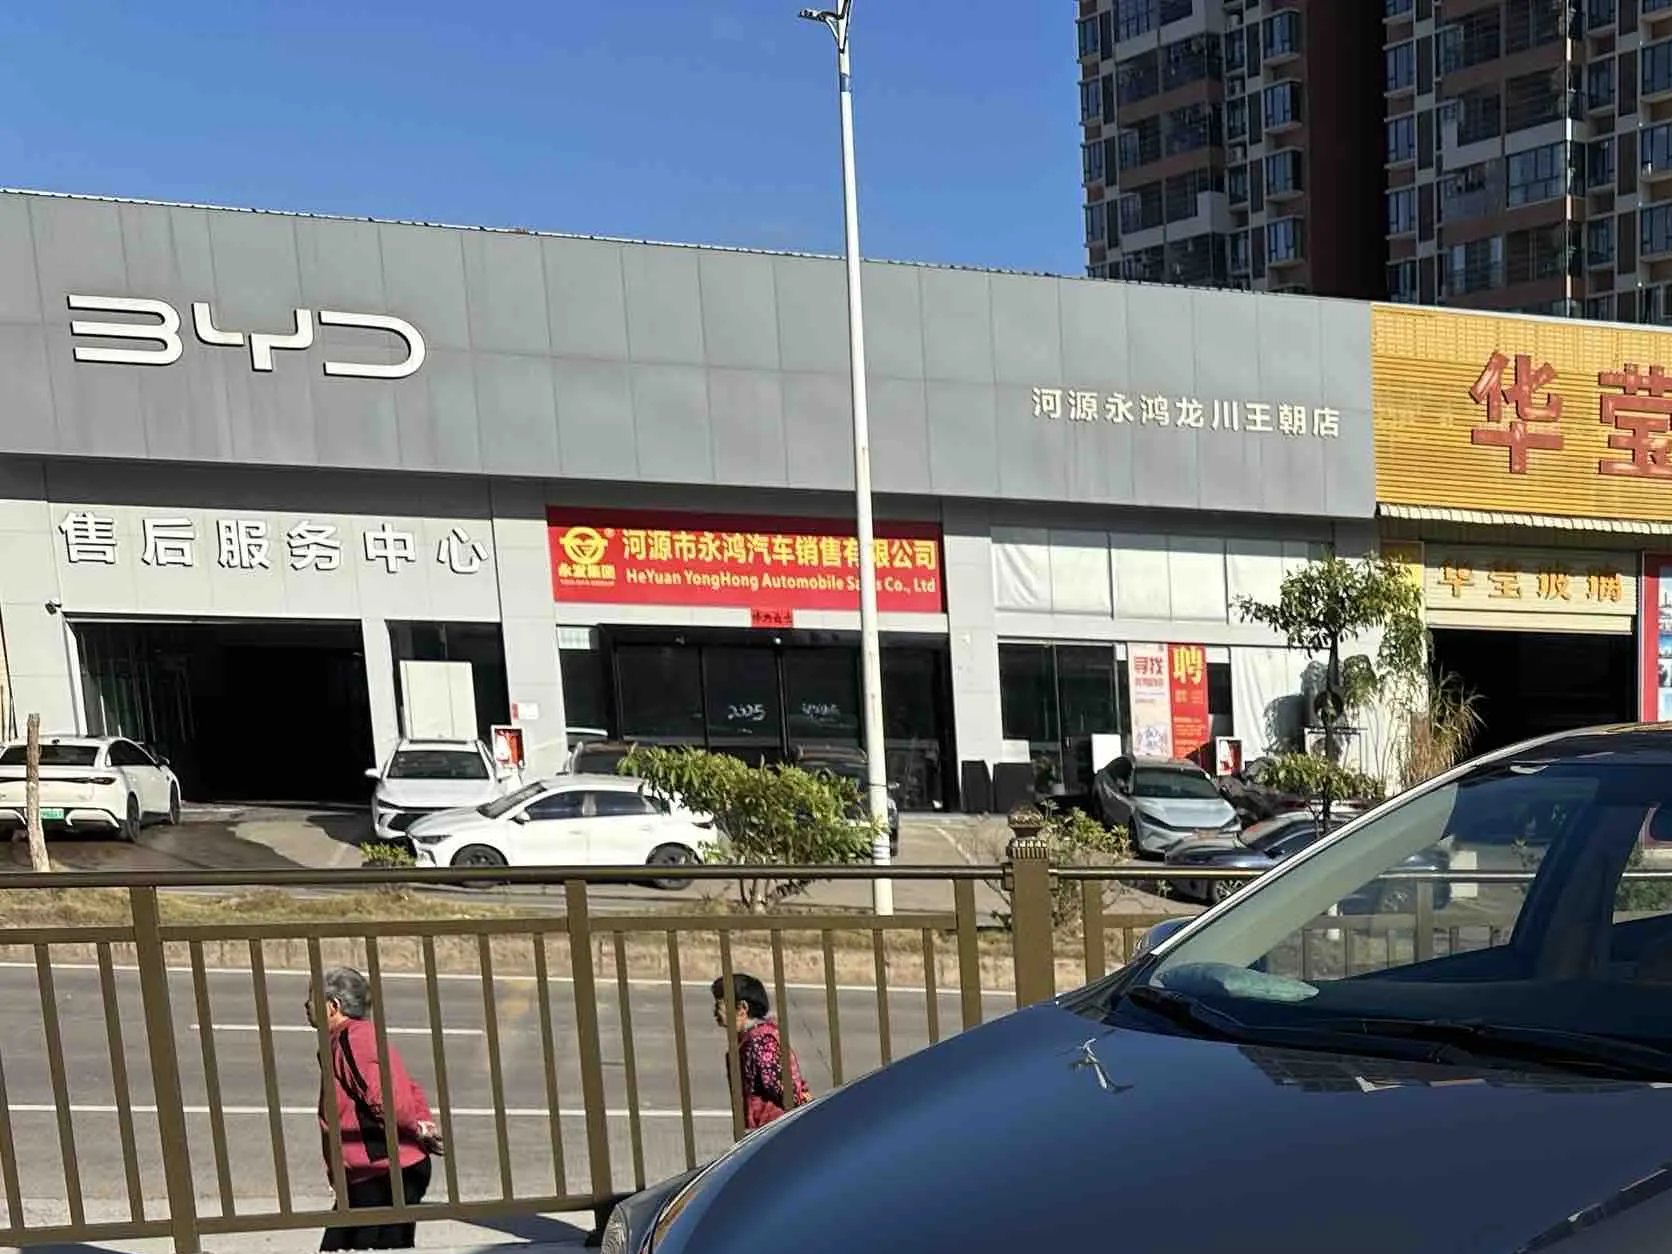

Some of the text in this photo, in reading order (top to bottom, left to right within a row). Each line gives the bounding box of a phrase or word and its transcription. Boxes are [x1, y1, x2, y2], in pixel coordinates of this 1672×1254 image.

[67, 294, 426, 378] BYD
[1032, 386, 1341, 438] 河源永鸿龙川王朝店
[58, 511, 488, 575] 售后服务中心
[626, 568, 681, 585] HeYuan
[684, 570, 759, 591] YongHong
[761, 573, 844, 591] Automobile
[914, 577, 937, 592] Ltd
